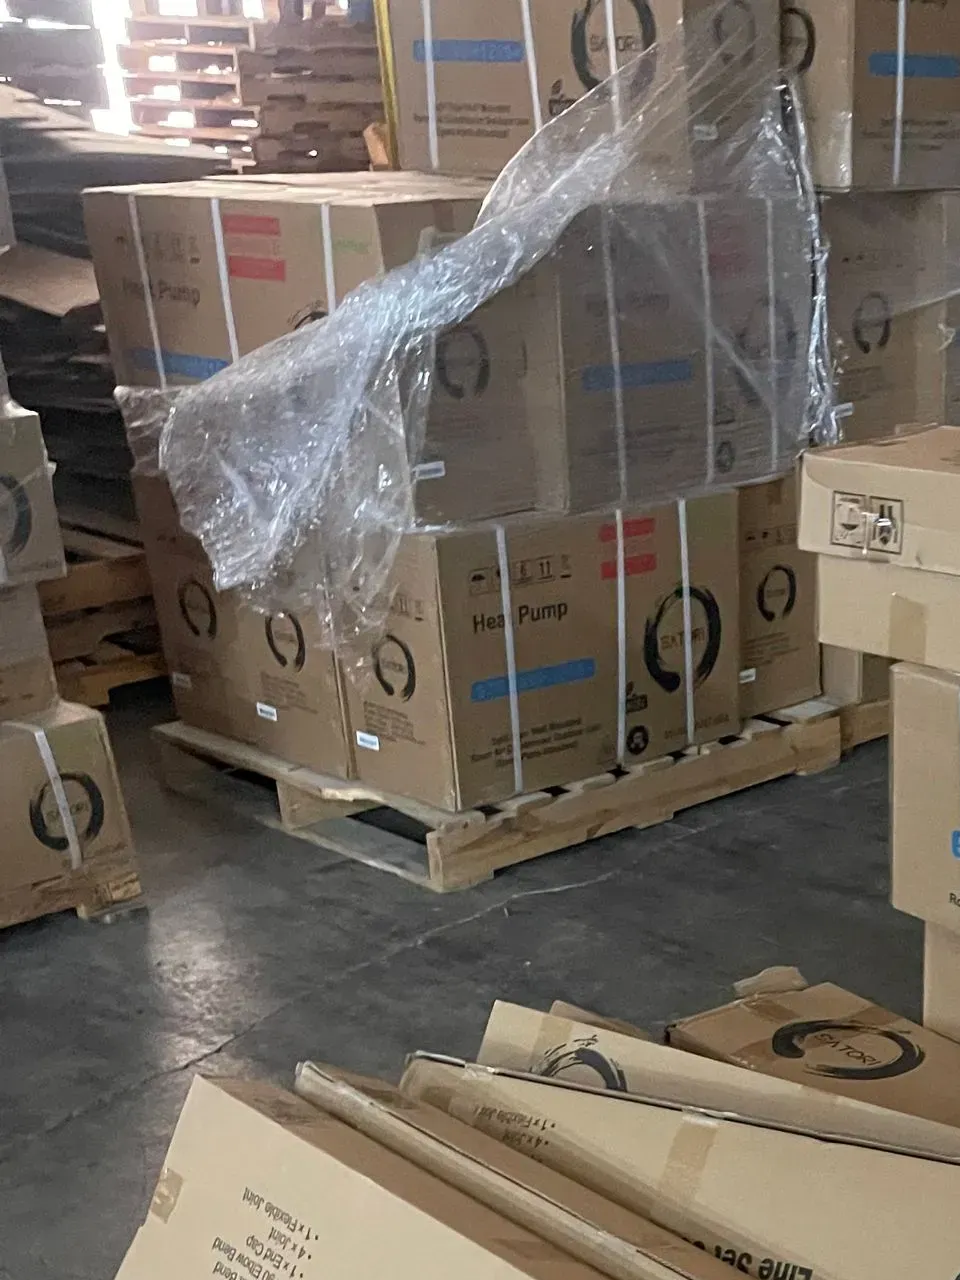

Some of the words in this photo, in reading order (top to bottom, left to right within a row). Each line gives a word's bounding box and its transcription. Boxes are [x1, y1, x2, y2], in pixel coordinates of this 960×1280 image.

[473, 614, 505, 634] Hea
[518, 602, 568, 626] Pump
[814, 1033, 882, 1065] SATORI
[242, 1187, 265, 1210] Joint
[265, 1201, 298, 1233] Flexible
[211, 1236, 237, 1262] Bend
[246, 1235, 264, 1256] Cap
[268, 1226, 292, 1250] Joint
[263, 1249, 283, 1269] End
[297, 1245, 306, 1259] 4
[236, 1252, 263, 1279] Elbow
